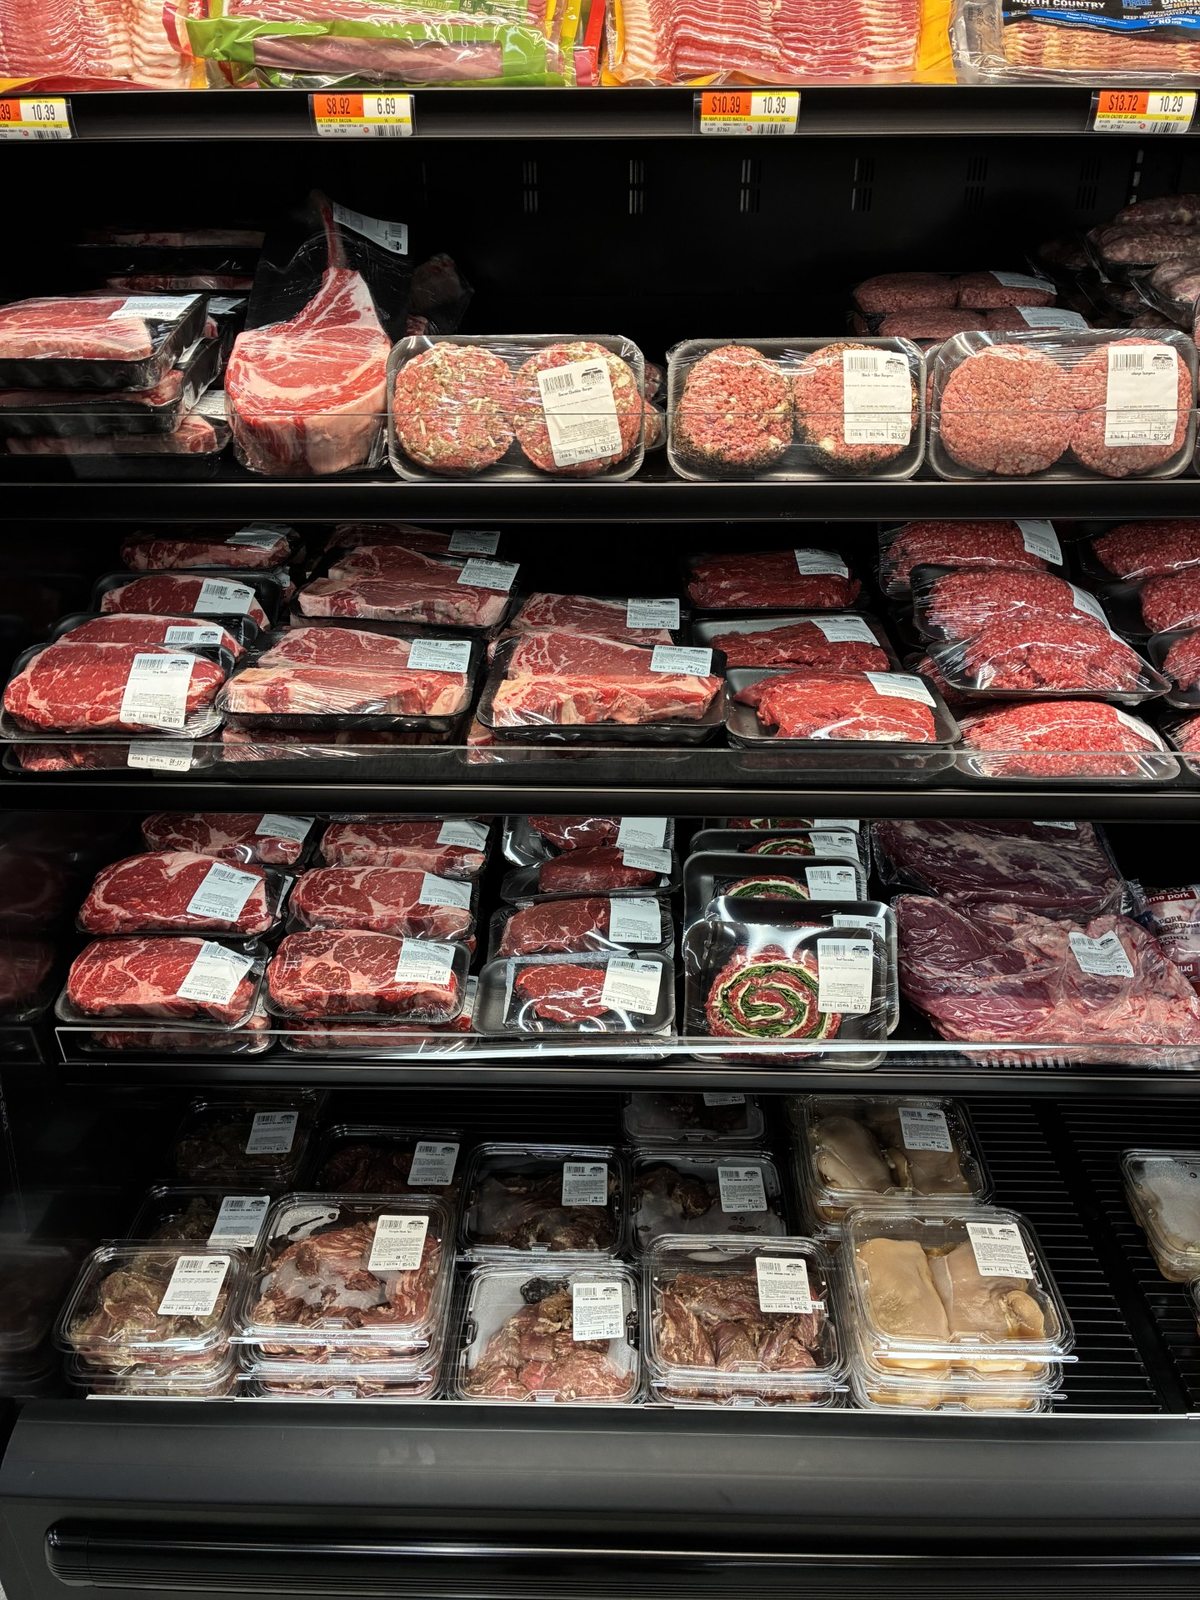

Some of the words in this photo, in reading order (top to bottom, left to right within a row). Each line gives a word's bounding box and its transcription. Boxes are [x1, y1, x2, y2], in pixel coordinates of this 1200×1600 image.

[1053, 0, 1106, 8] COUNTRY
[326, 98, 350, 114] $8.92
[377, 98, 395, 114] 6.69
[712, 96, 740, 113] $10.39
[763, 96, 786, 114] 10.39
[1108, 94, 1138, 111] $13.72
[1160, 96, 1183, 112] 10.29
[32, 104, 55, 120] 10.39
[1167, 892, 1190, 900] pork
[1159, 915, 1182, 924] PORK
